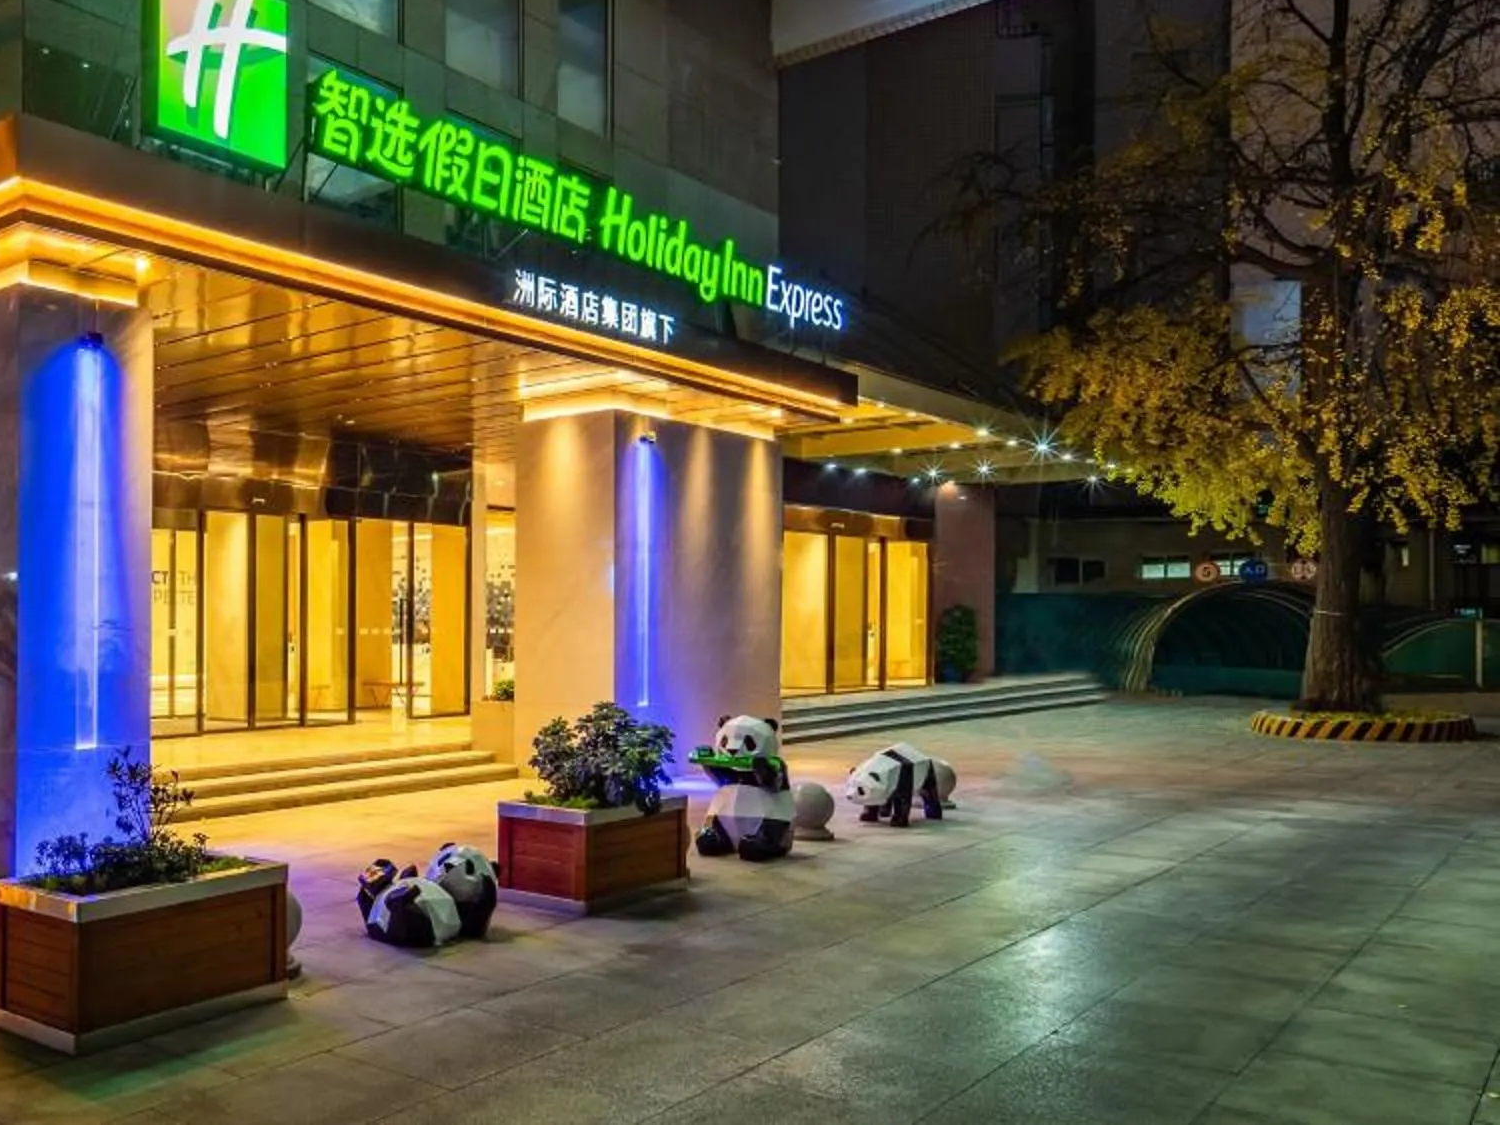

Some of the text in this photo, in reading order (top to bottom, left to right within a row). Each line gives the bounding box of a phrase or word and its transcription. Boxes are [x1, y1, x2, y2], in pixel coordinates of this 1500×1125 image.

[315, 69, 590, 243] 智选假日酒店
[766, 265, 843, 330] Express
[512, 269, 675, 344] 洲际酒店集团旗下
